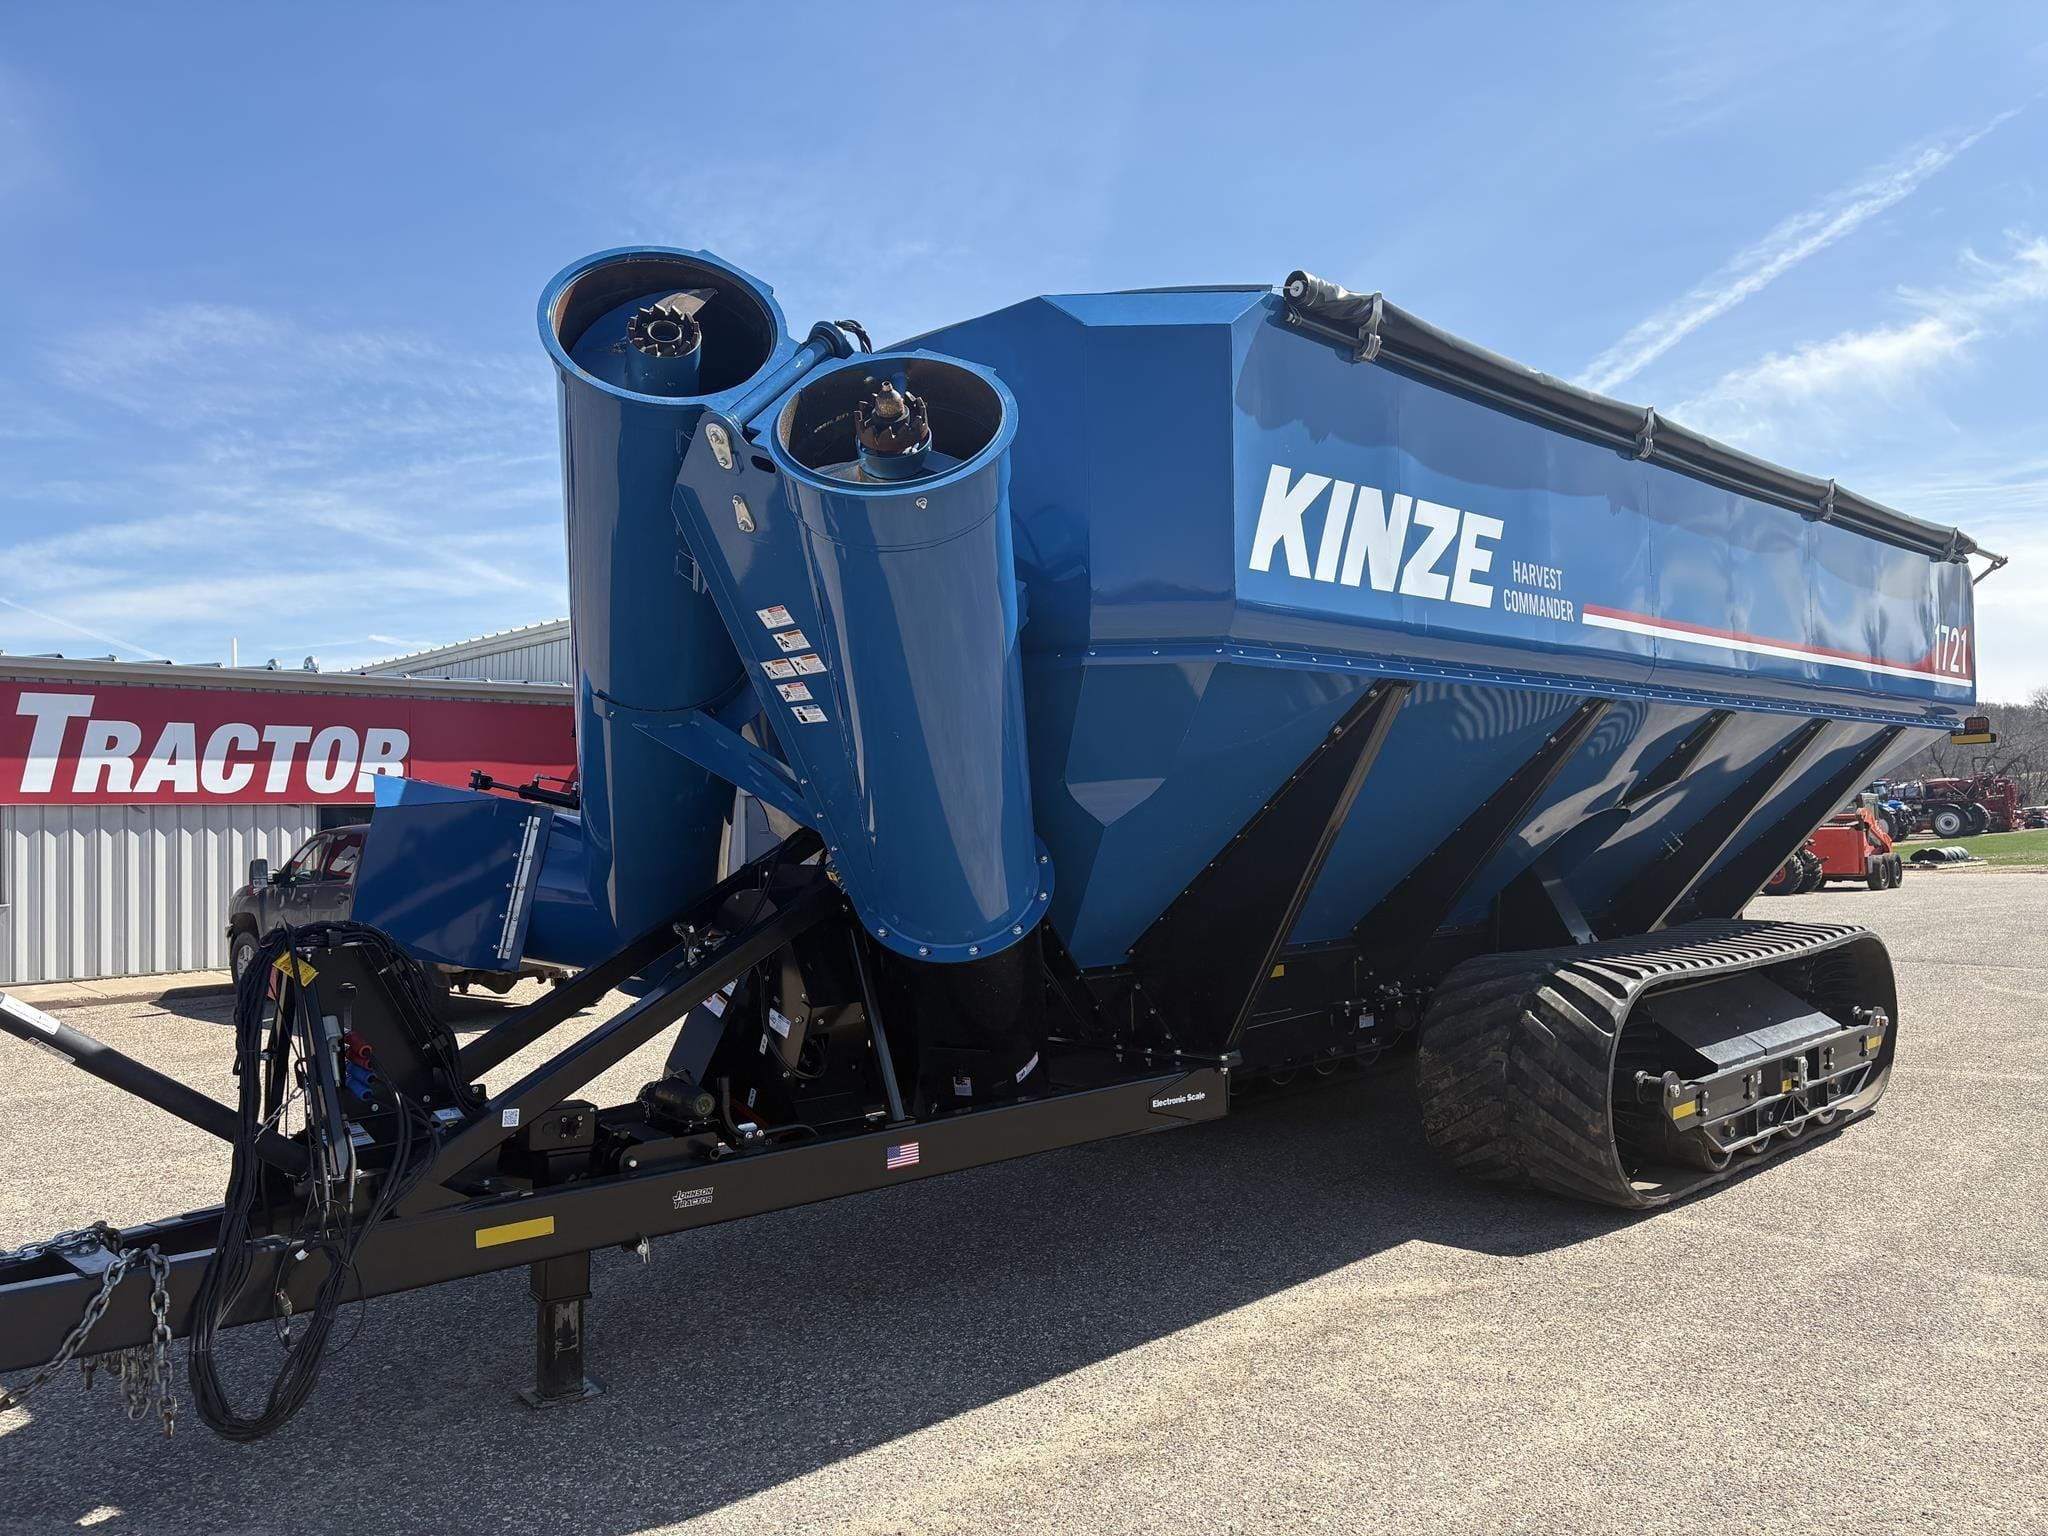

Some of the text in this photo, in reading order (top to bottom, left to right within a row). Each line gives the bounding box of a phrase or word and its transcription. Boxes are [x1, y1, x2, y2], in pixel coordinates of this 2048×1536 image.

[1249, 464, 1505, 608] KINZE
[1512, 560, 1563, 591] HARVEST
[1503, 588, 1575, 622] COMMANDER
[1935, 623, 1968, 675] 1721
[16, 692, 411, 795] TRACTOR
[1152, 1091, 1206, 1108] Electronic Scale
[673, 1186, 714, 1201] JOHNSON
